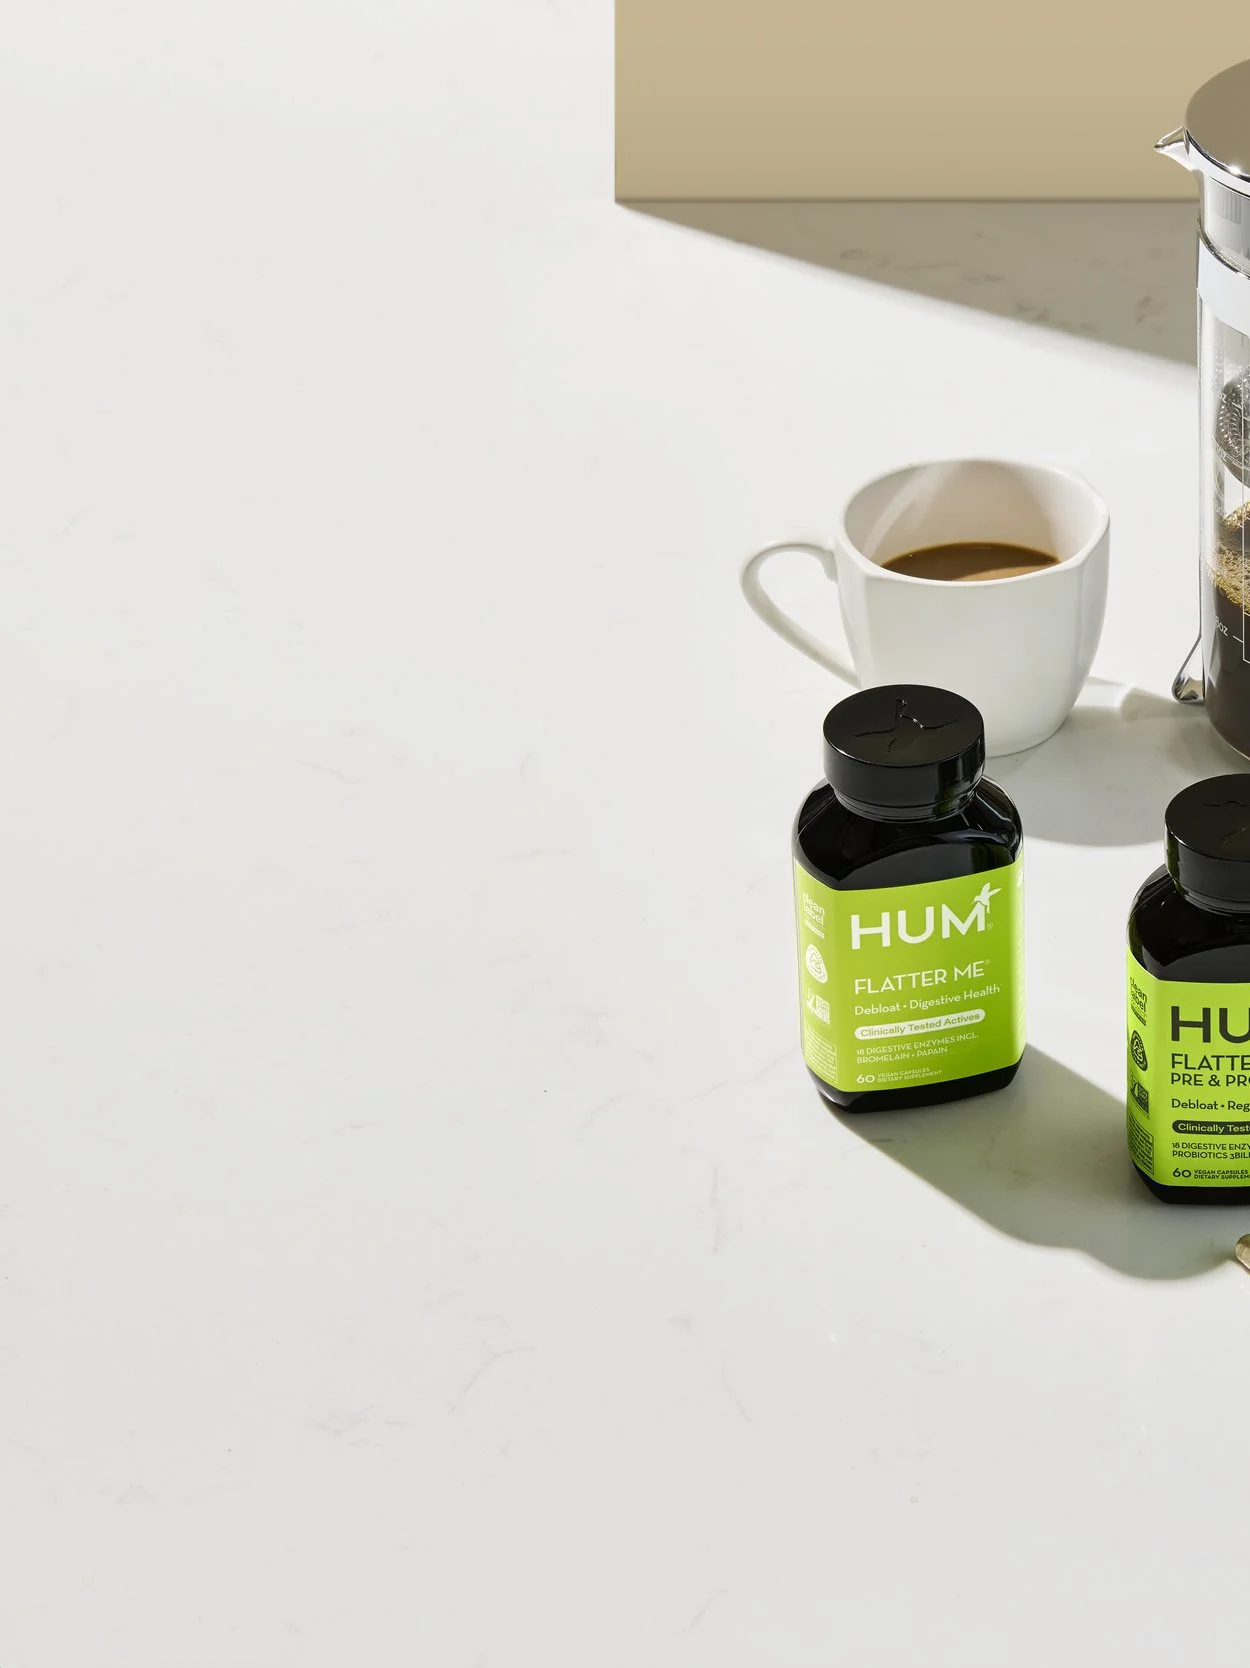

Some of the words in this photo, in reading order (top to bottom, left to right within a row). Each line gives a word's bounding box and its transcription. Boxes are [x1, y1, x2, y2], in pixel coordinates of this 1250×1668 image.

[854, 969, 947, 995] FLATTER
[854, 1002, 900, 1016] Debloat
[909, 994, 961, 1010] Digestive
[860, 1025, 906, 1037] Clinically
[908, 1020, 941, 1031] Tested
[943, 1012, 980, 1026] Actives
[866, 1042, 912, 1055] DIGESTIVE
[913, 1036, 956, 1049] ENZYMES
[856, 1052, 910, 1064] BROMELAIN
[916, 1046, 948, 1057] PAPAIN
[856, 1073, 875, 1084] 60
[1171, 1072, 1203, 1086] PRE
[1208, 1075, 1221, 1087] &
[1171, 1098, 1219, 1110] Debloat
[1178, 1122, 1224, 1134] Clinically
[1181, 1142, 1227, 1150] DIGESTIVE
[1172, 1150, 1228, 1159] PROBIOTICS
[1172, 1167, 1191, 1178] 60
